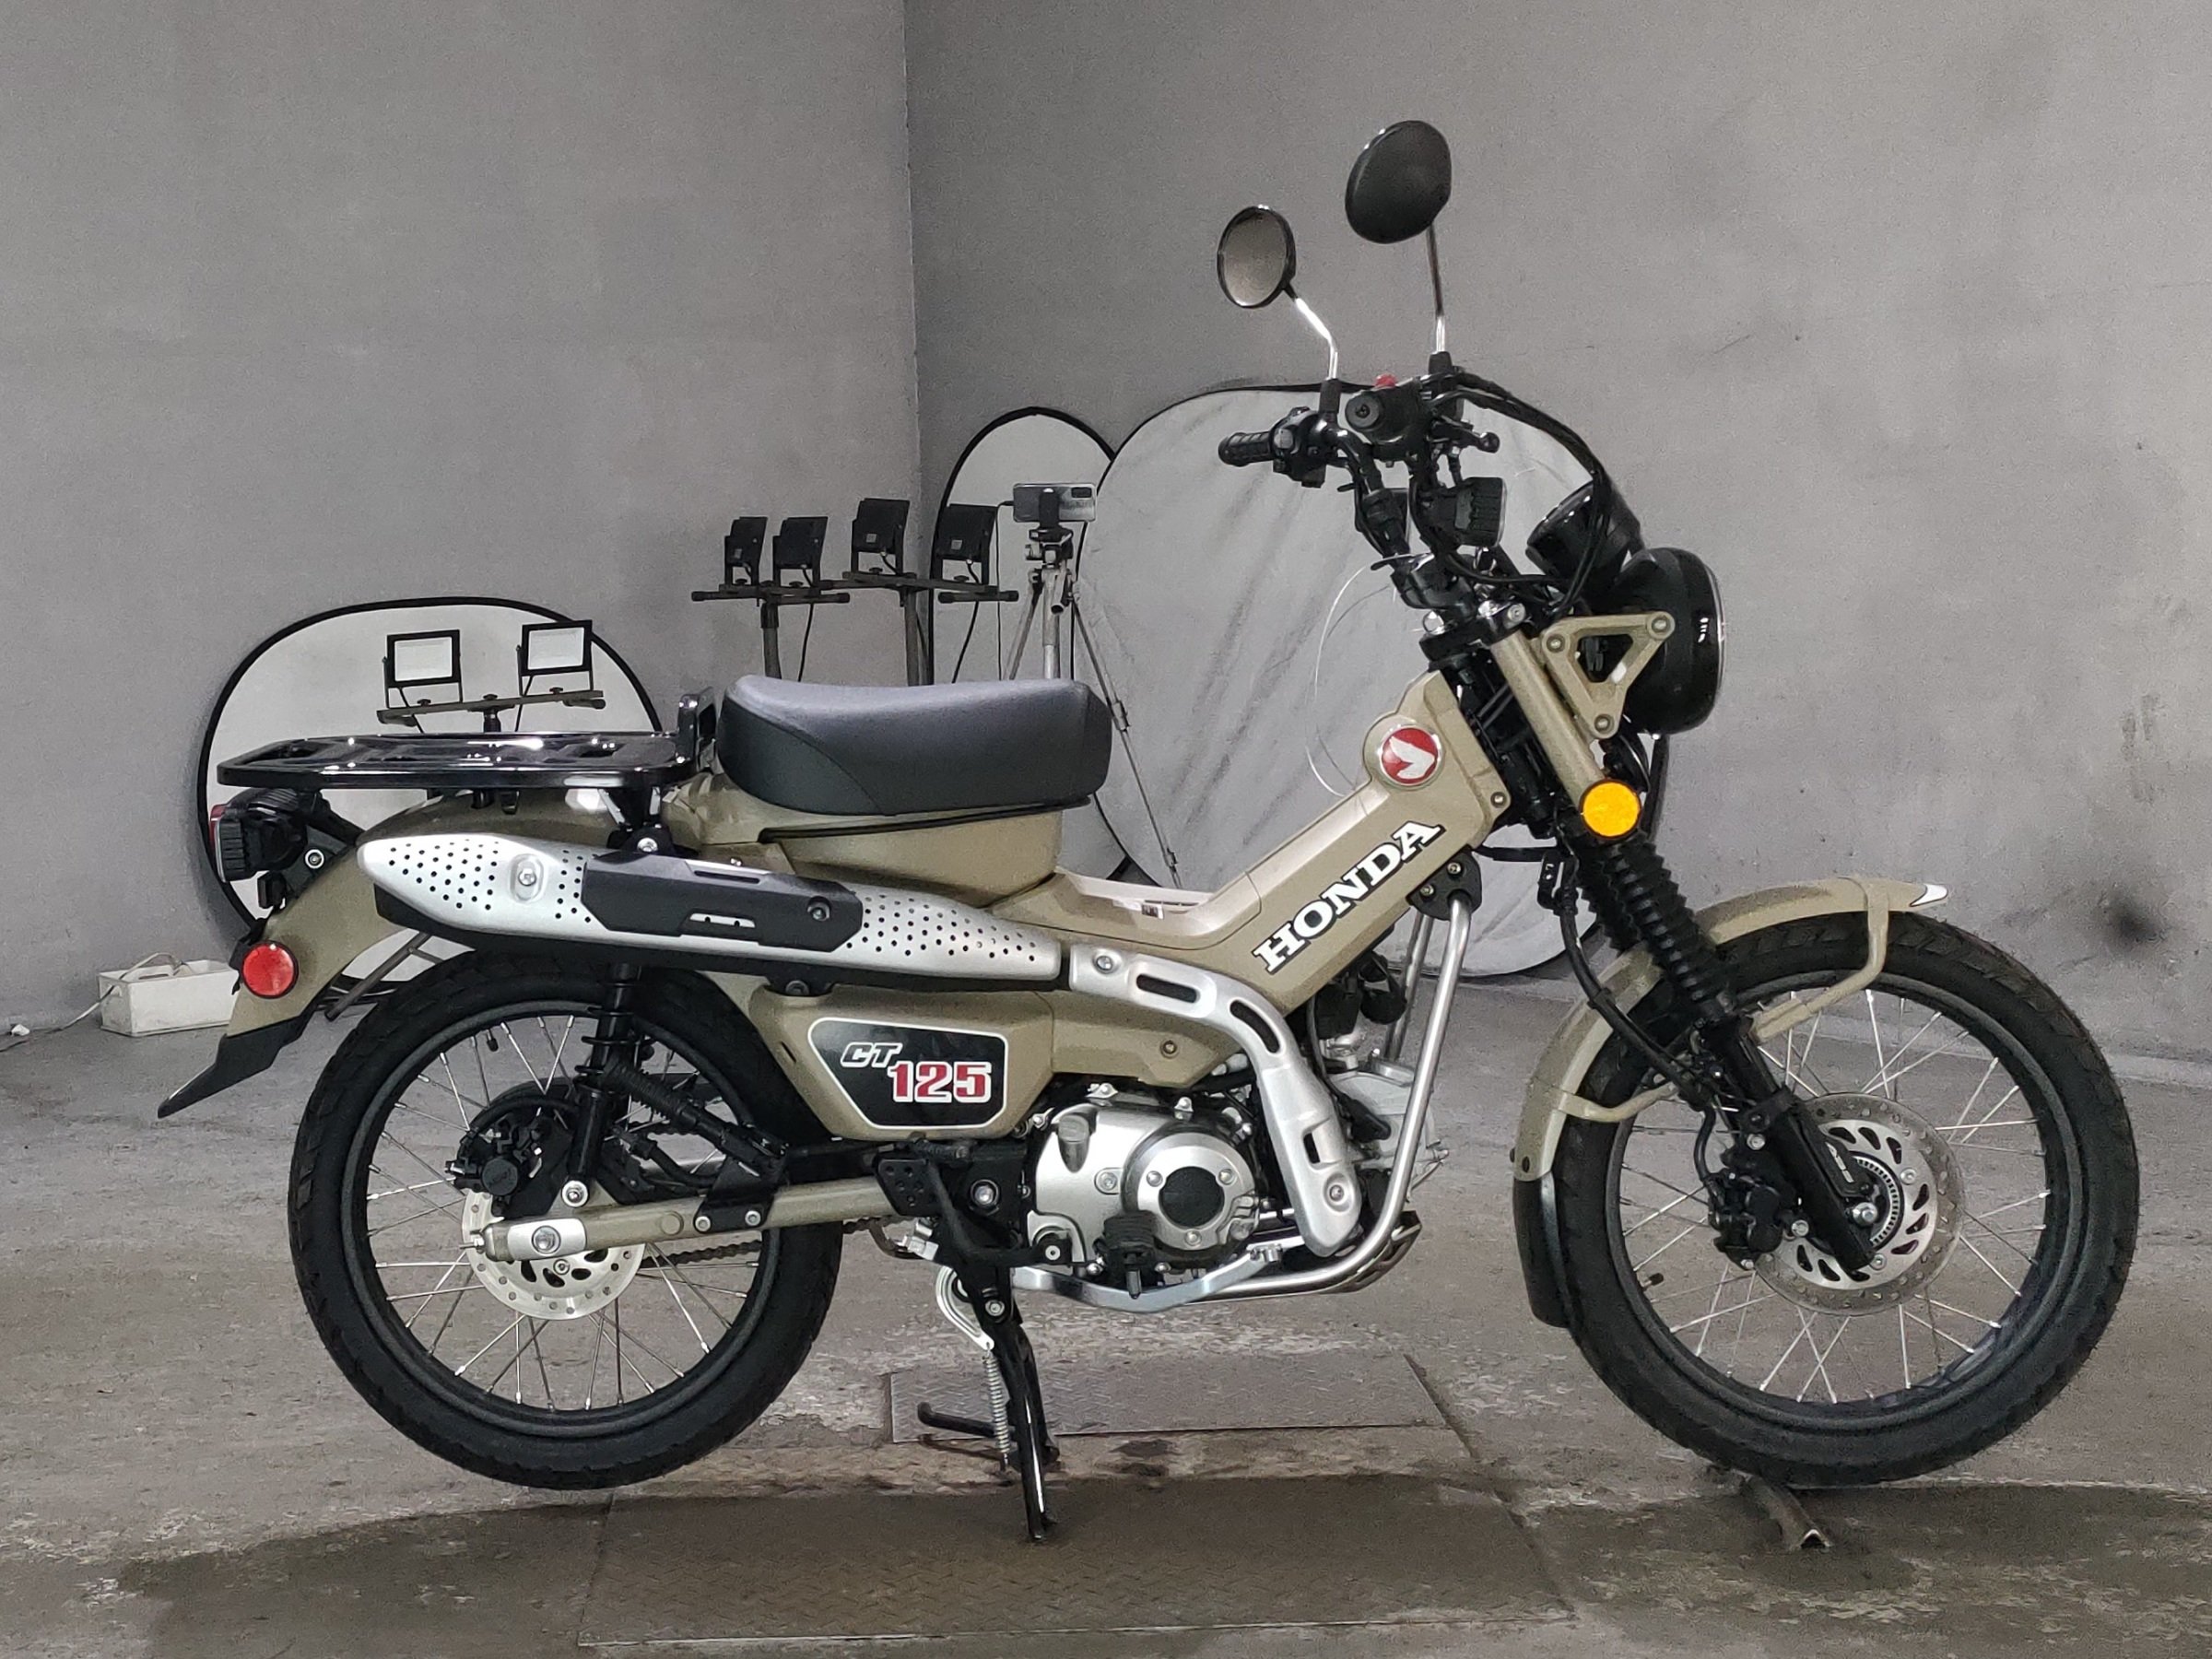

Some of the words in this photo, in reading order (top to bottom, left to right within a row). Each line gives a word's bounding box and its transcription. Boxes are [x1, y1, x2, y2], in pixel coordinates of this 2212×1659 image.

[1252, 821, 1446, 975] HONDA
[840, 1042, 902, 1067] CT
[888, 1061, 991, 1102] 125
